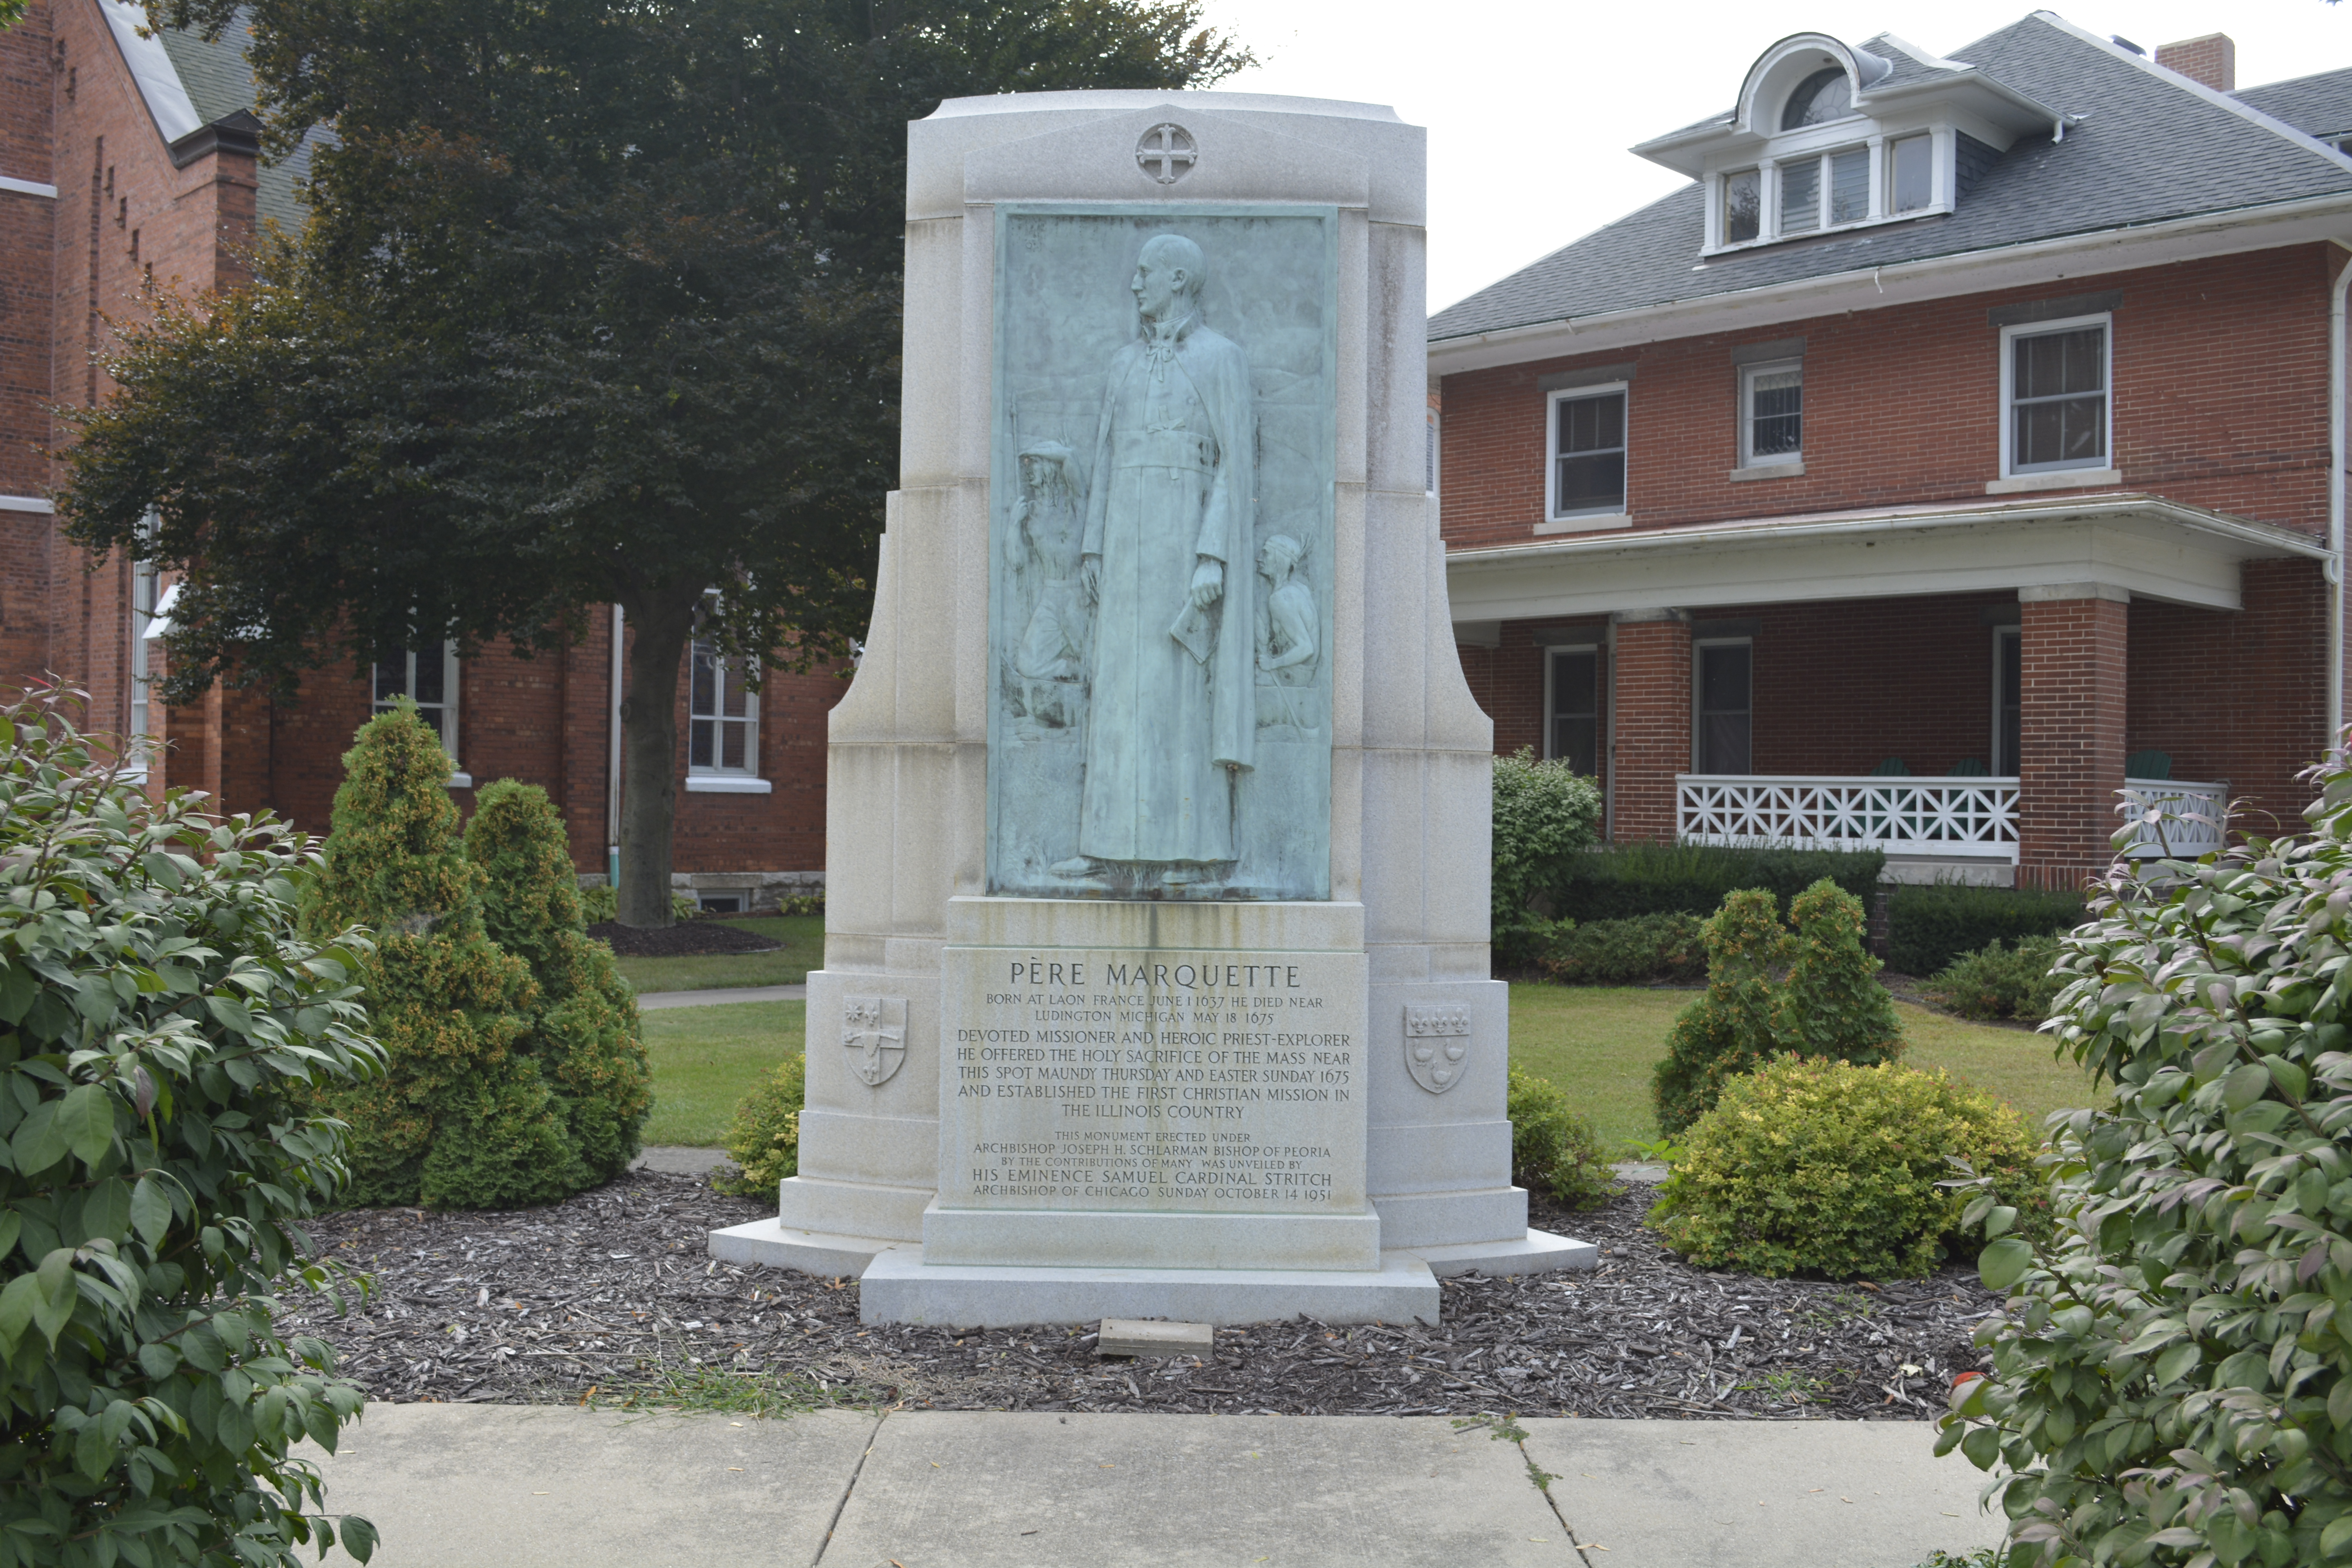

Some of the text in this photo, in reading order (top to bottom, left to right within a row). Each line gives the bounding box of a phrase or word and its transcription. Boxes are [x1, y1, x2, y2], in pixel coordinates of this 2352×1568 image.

[1011, 956, 1300, 989] PÈRE MARQUETTE
[987, 993, 1323, 1009] BORN AT LAON FRANCE JUNE 1 1637 HE DIED NEAR
[1036, 1010, 1274, 1026] LUDINGTON MICHIGAN MAY 18 1675
[958, 1029, 1350, 1046] DEVOTED MISSIONER AND HEROIC PRIEST-EXPLORER
[958, 1047, 1350, 1065] HE OFFERED THE HOLY SACRIFICE OF THE MASS NEAR
[958, 1066, 1349, 1085] THIS SPOT MAUNDY THURSDAY AND EASTER SUNDAY 1675
[958, 1085, 1349, 1102] AND ESTABLISHED THE FIRST CHRISTIAN MISSION IN
[1062, 1104, 1244, 1119] THE ILLINOIS COUNTRY
[1055, 1131, 1250, 1142] THIS MONUMENT ERECTED UNDER
[973, 1143, 1331, 1158] ARCHBISHOP JOSEPH H. SCHLARMAN BISHOP OF PEORIA
[1002, 1157, 1302, 1169] BY THE CONTRIBUTIONS OF MANY WAS UNVEILED BY
[973, 1169, 1331, 1186] HIS EMINENCE SAMUEL CARDINAL STRITCH
[973, 1185, 1330, 1202] ARCHBISHOP OF CHICAGO SUNDAY OCTOBER 14 1951
